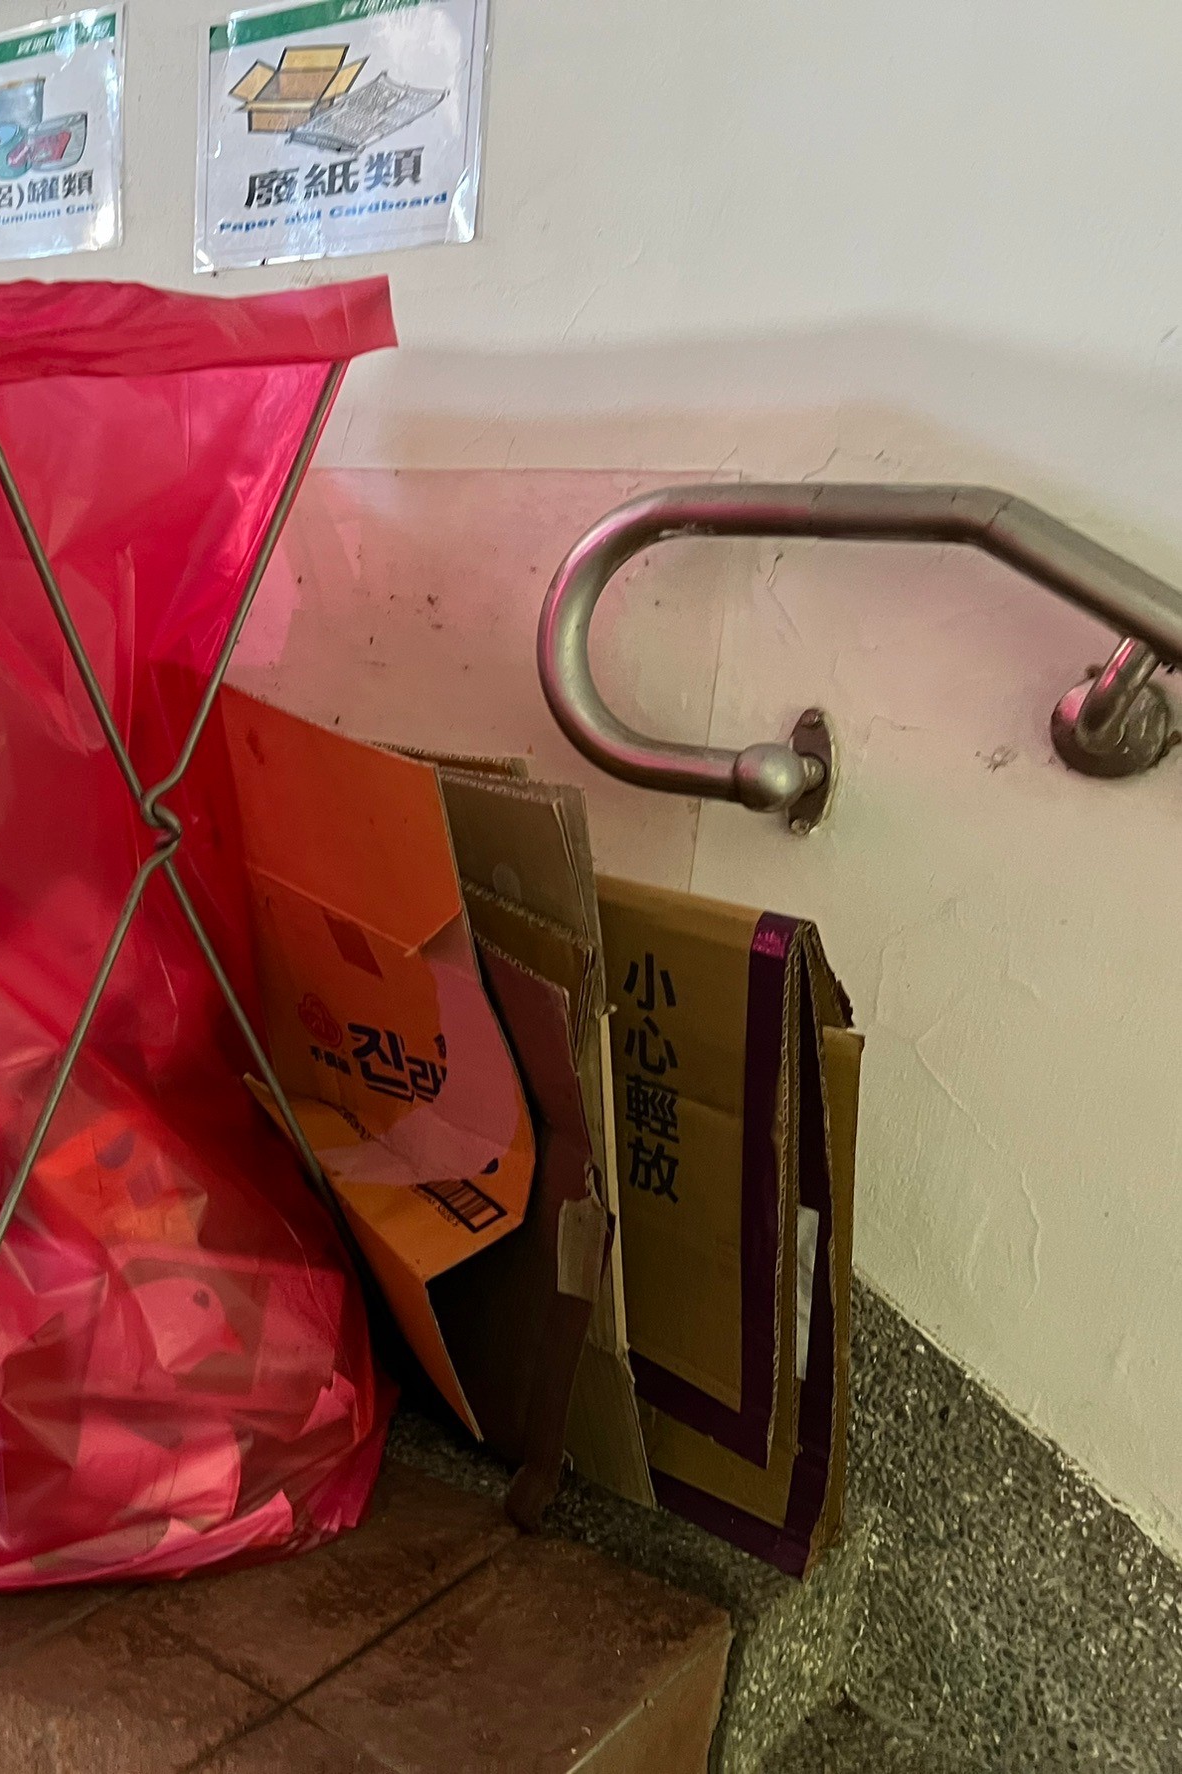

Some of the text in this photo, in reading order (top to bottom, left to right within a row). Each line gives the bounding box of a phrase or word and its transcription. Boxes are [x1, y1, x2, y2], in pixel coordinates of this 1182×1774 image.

[244, 146, 425, 210] 廢紙類
[218, 190, 449, 233] Paper and Cardboard
[622, 951, 681, 1205] 小心輕放
